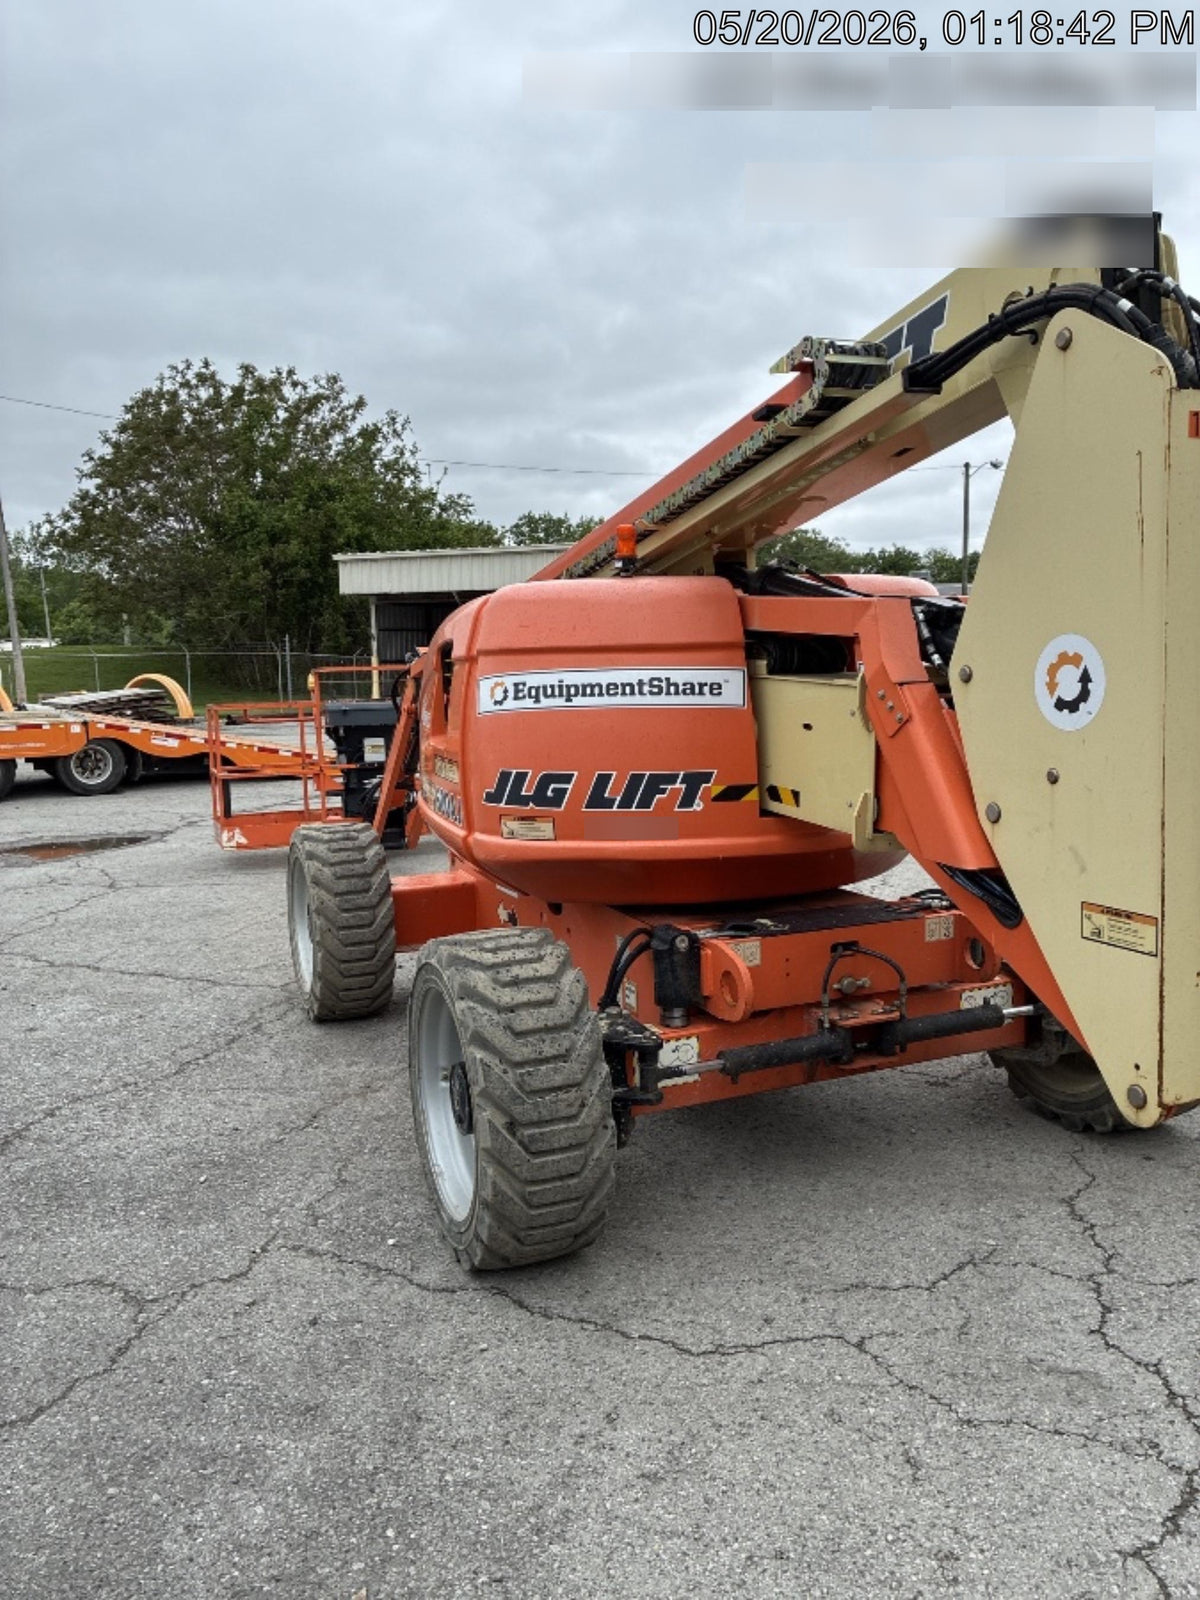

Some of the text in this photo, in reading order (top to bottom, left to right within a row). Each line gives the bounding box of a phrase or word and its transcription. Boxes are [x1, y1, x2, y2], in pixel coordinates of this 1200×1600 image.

[512, 677, 723, 704] EquipmentShare
[482, 769, 577, 810] JLG
[582, 769, 717, 811] LIFT
